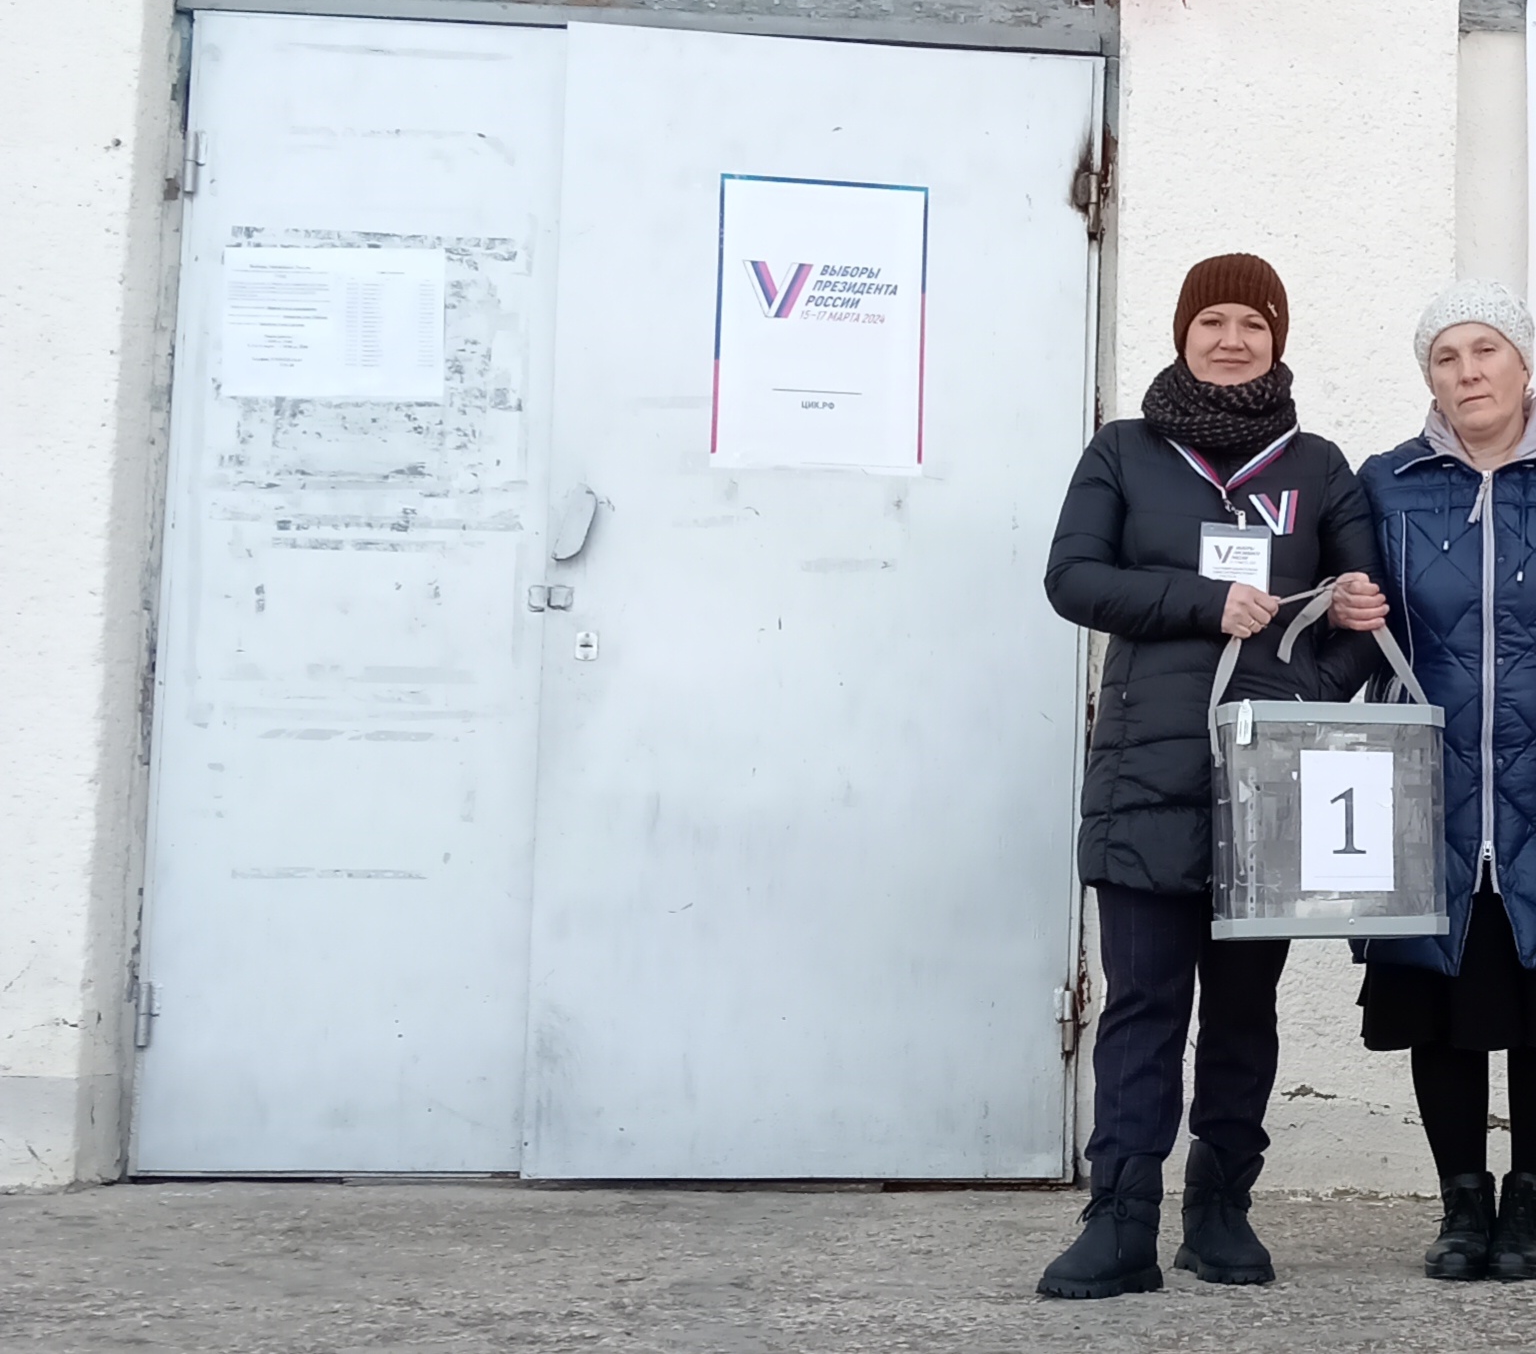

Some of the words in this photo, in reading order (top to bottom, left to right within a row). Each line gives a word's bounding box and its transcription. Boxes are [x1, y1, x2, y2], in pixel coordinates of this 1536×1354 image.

[820, 264, 881, 279] ВЫБОРЫ
[812, 280, 898, 296] ПРЕЗИДЕНТА
[805, 295, 861, 309] РОССИИ
[826, 311, 861, 323] МАРТА
[861, 313, 886, 324] 2024
[1330, 787, 1367, 855] 1
